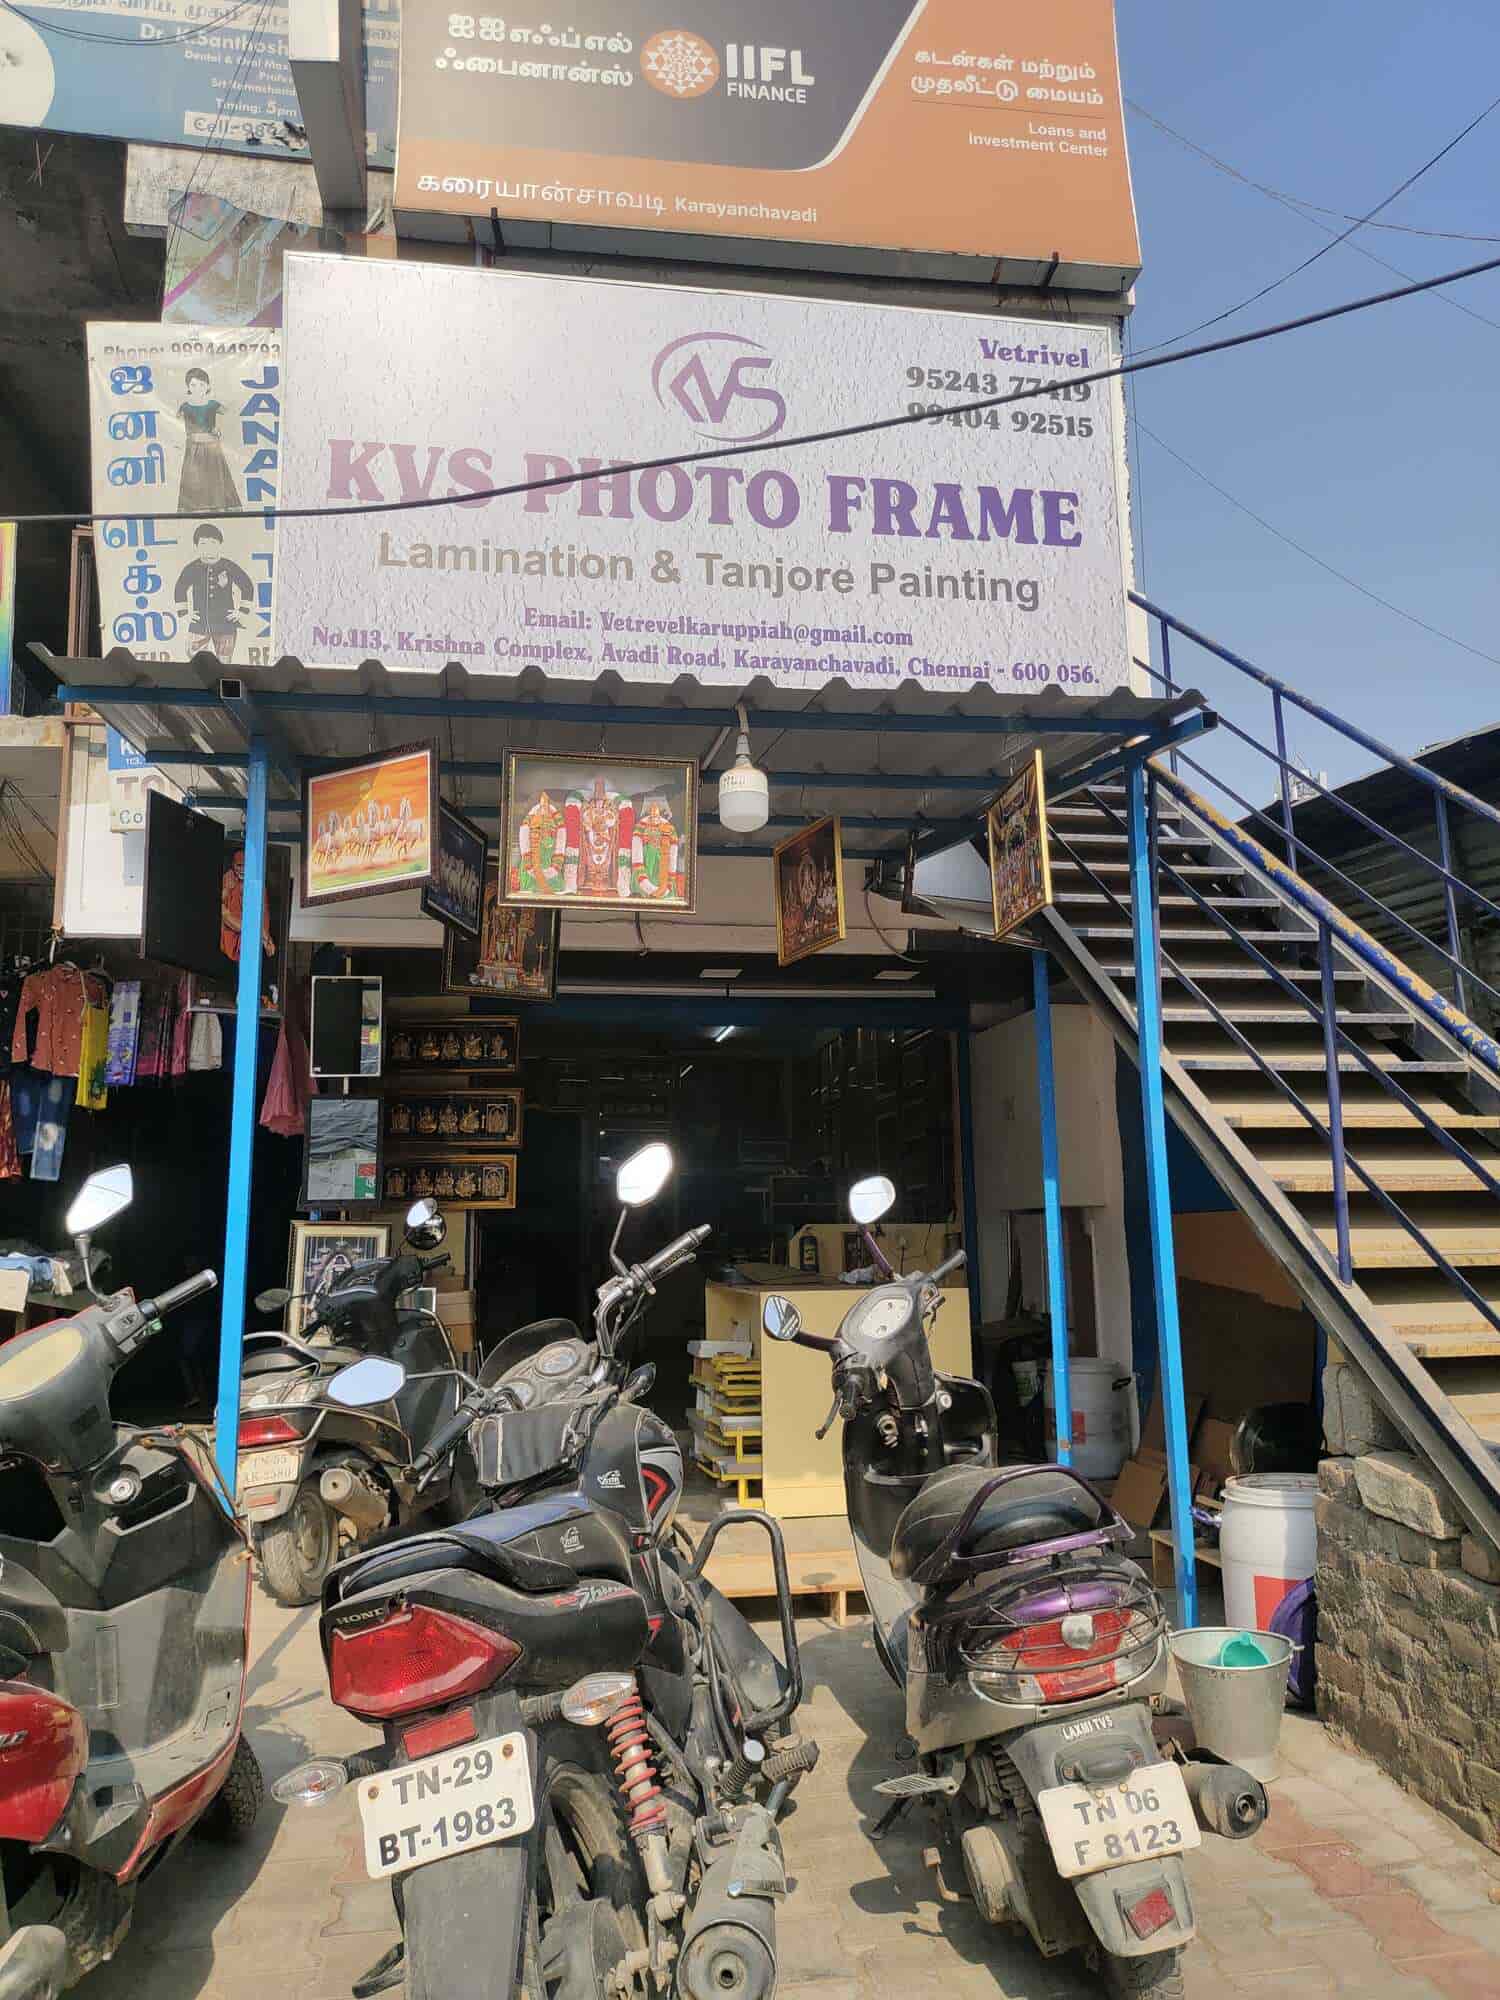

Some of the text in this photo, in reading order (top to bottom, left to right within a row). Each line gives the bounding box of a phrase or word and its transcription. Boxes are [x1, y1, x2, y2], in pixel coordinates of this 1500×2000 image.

[726, 43, 815, 86] IIFL
[914, 49, 1096, 84] கடன்கள் மற்றும்
[726, 82, 807, 104] FINANCE
[911, 73, 1104, 106] முதலீட்டு மையம்
[968, 130, 1109, 157] Investment Center
[1028, 121, 1106, 141] Loans and
[416, 172, 669, 217] கரையான்சாவடி
[674, 196, 818, 224] Karayanchavadi
[978, 337, 1090, 369] Vetrivel
[905, 366, 999, 395] 95243
[1011, 410, 1094, 438] 92515
[326, 438, 1083, 548] KVS PHOTO FRAME
[377, 533, 1040, 612] Lamination & Tanjore Painting
[523, 607, 914, 646] Email: Vetrevelkaruppiah@gmail.com
[399, 631, 486, 656] Krishna
[494, 636, 594, 662] Complex,
[600, 642, 660, 664] Avadi
[667, 645, 727, 669] Road,
[734, 648, 902, 676] Karayanchavadi,
[908, 656, 990, 680] Chennai
[1012, 662, 1050, 682] 600
[1057, 664, 1100, 684] 056.
[1062, 1714, 1114, 1740] LAXMI TVS
[391, 1750, 493, 1806] TN-29
[1073, 1788, 1160, 1826] TN 06
[379, 1797, 517, 1867] BT-1983
[1074, 1819, 1183, 1866] F 8123
